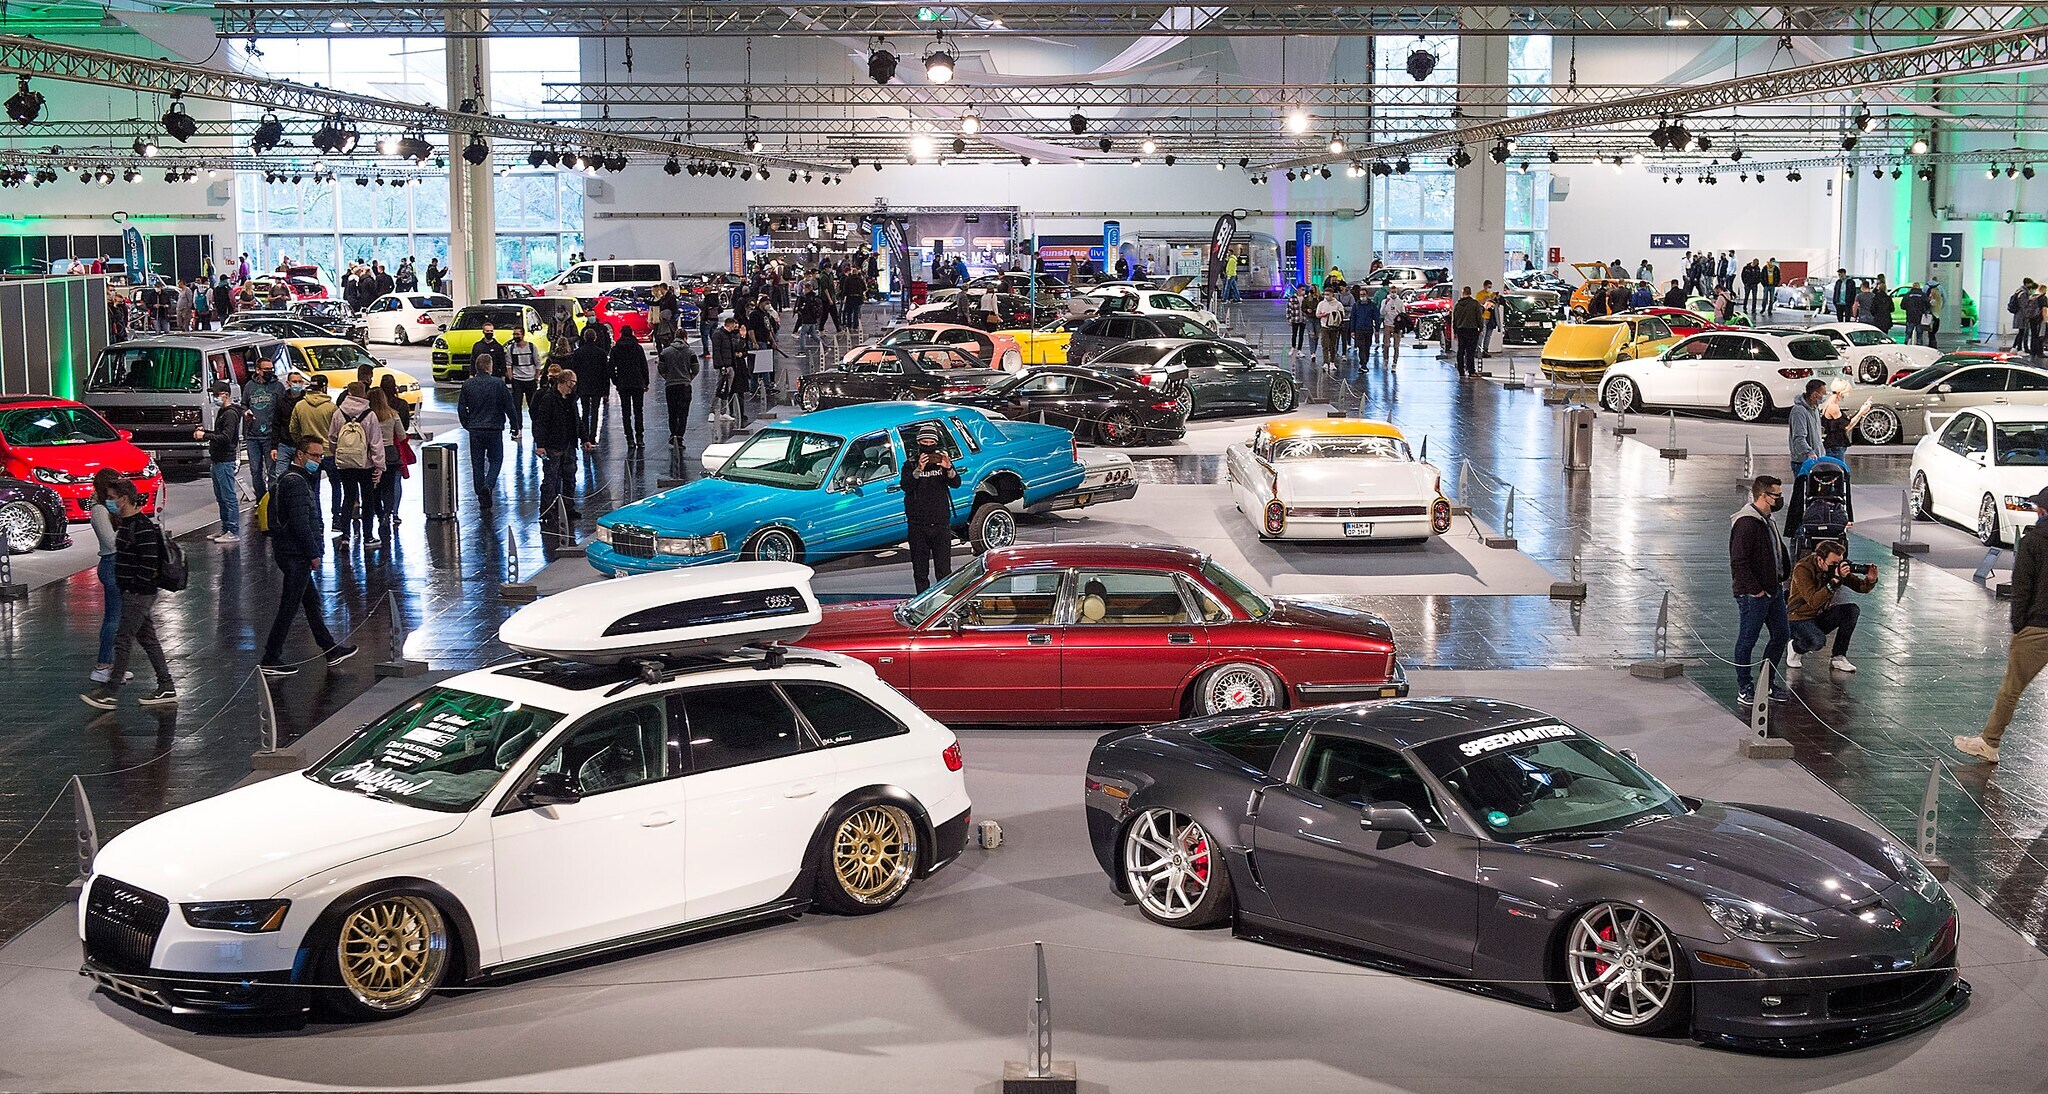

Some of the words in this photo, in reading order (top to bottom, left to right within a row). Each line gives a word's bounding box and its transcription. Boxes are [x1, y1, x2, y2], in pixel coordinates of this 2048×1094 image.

[1041, 249, 1087, 257] sunshine
[1940, 237, 1952, 258] 5
[1458, 725, 1576, 757] SPEEDHUNTERS
